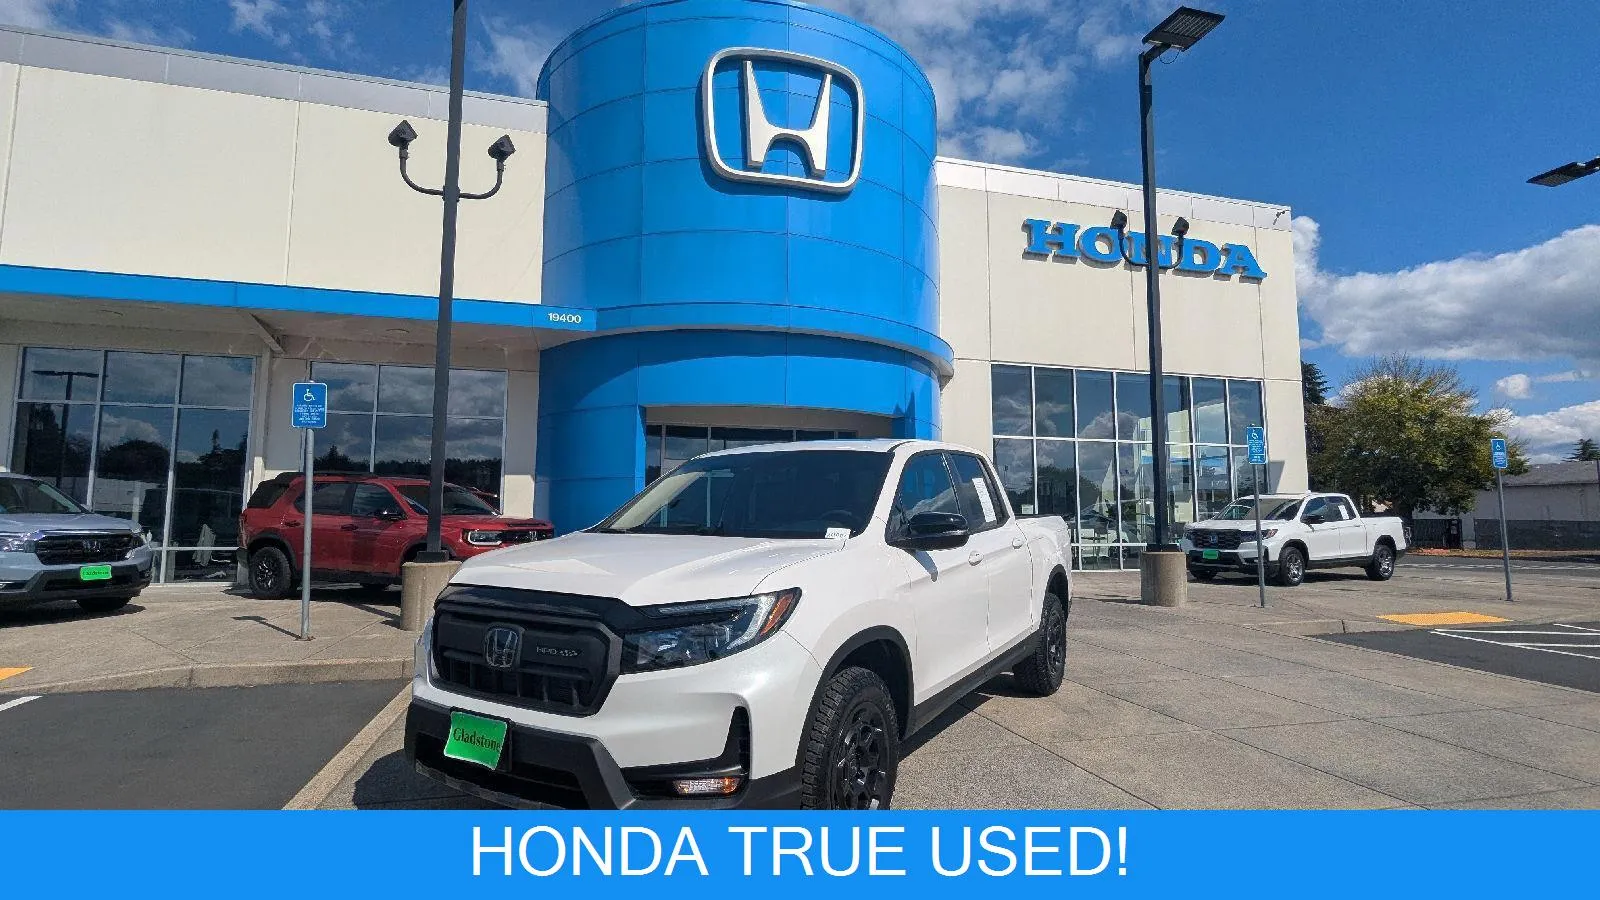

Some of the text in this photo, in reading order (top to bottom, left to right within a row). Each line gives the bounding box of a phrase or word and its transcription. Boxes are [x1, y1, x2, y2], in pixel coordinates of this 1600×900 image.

[1022, 218, 1268, 282] HONDA
[547, 312, 582, 324] 19400
[453, 727, 502, 752] Gladstone
